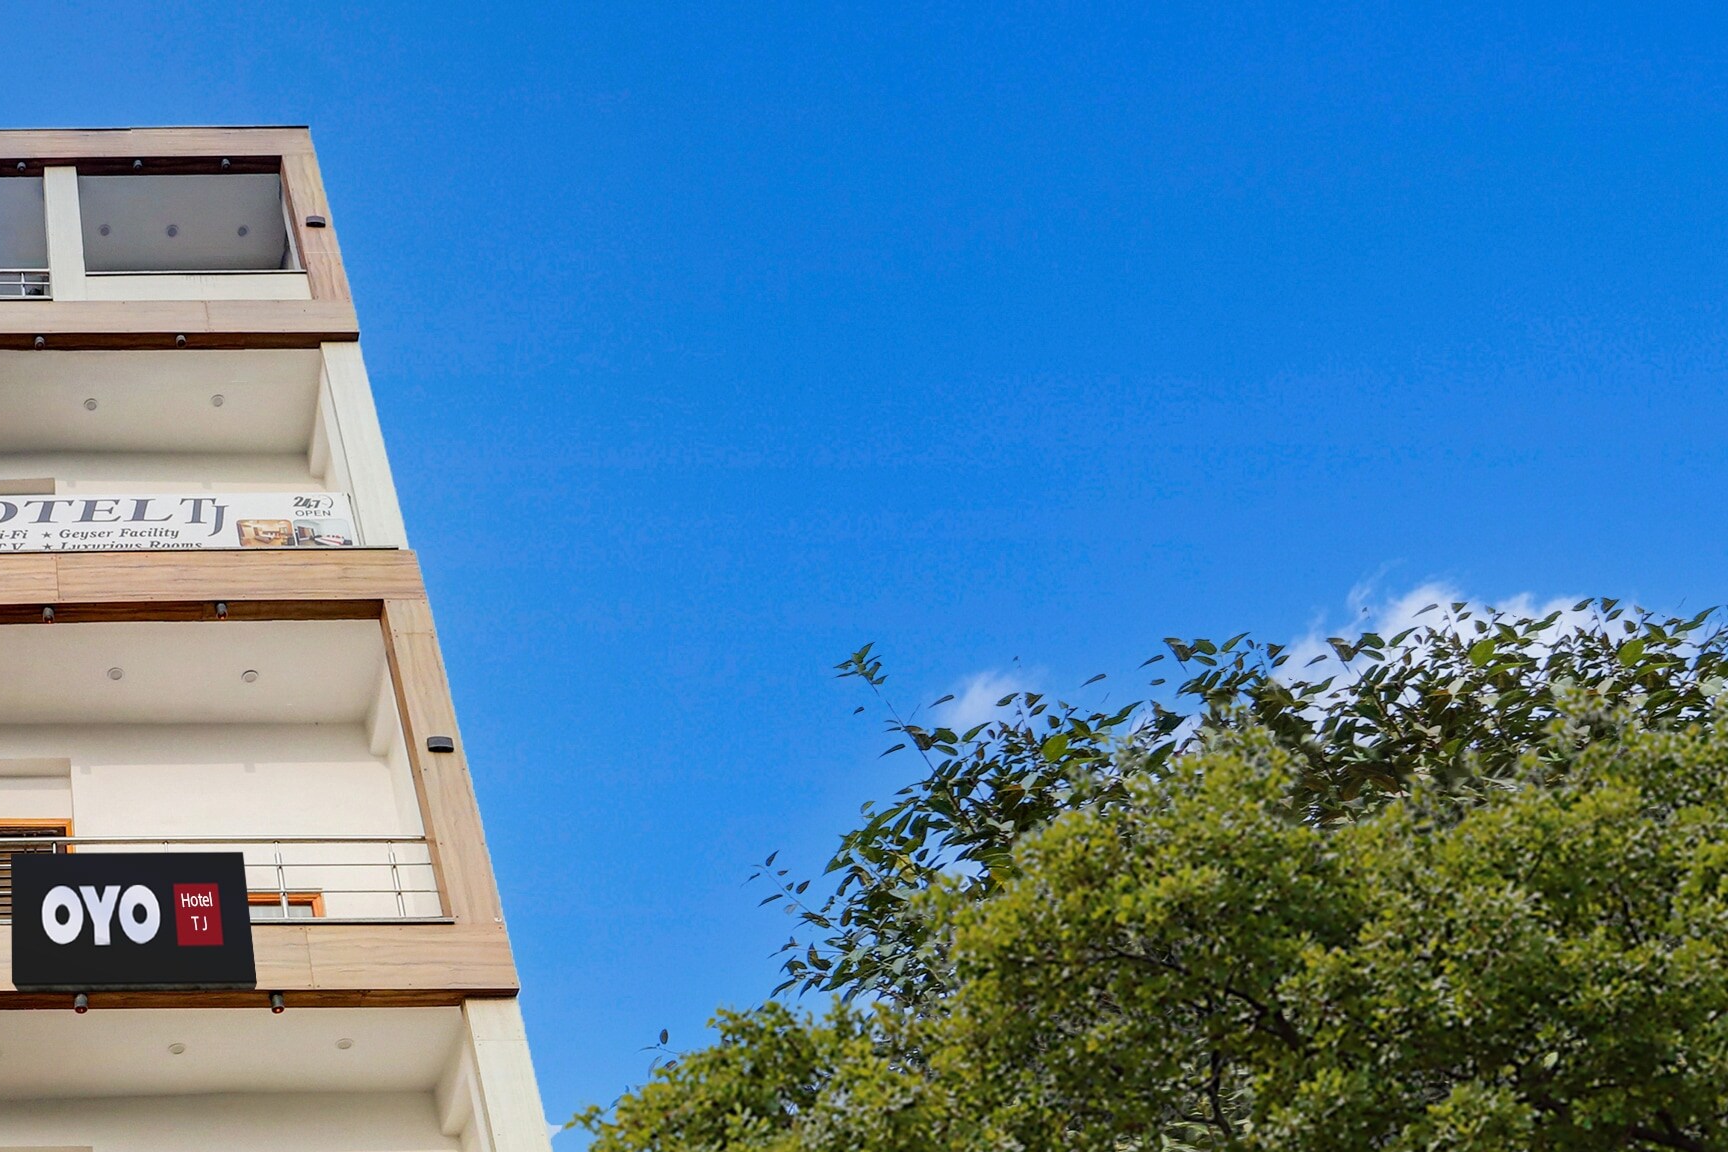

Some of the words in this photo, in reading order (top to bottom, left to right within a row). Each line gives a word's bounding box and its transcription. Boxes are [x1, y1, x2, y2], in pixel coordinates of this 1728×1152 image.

[179, 498, 229, 537] TJ
[295, 509, 332, 517] OPEN
[59, 529, 113, 541] Geyser
[119, 528, 180, 540] Facility
[180, 891, 214, 908] Hotel
[41, 884, 161, 946] OYO
